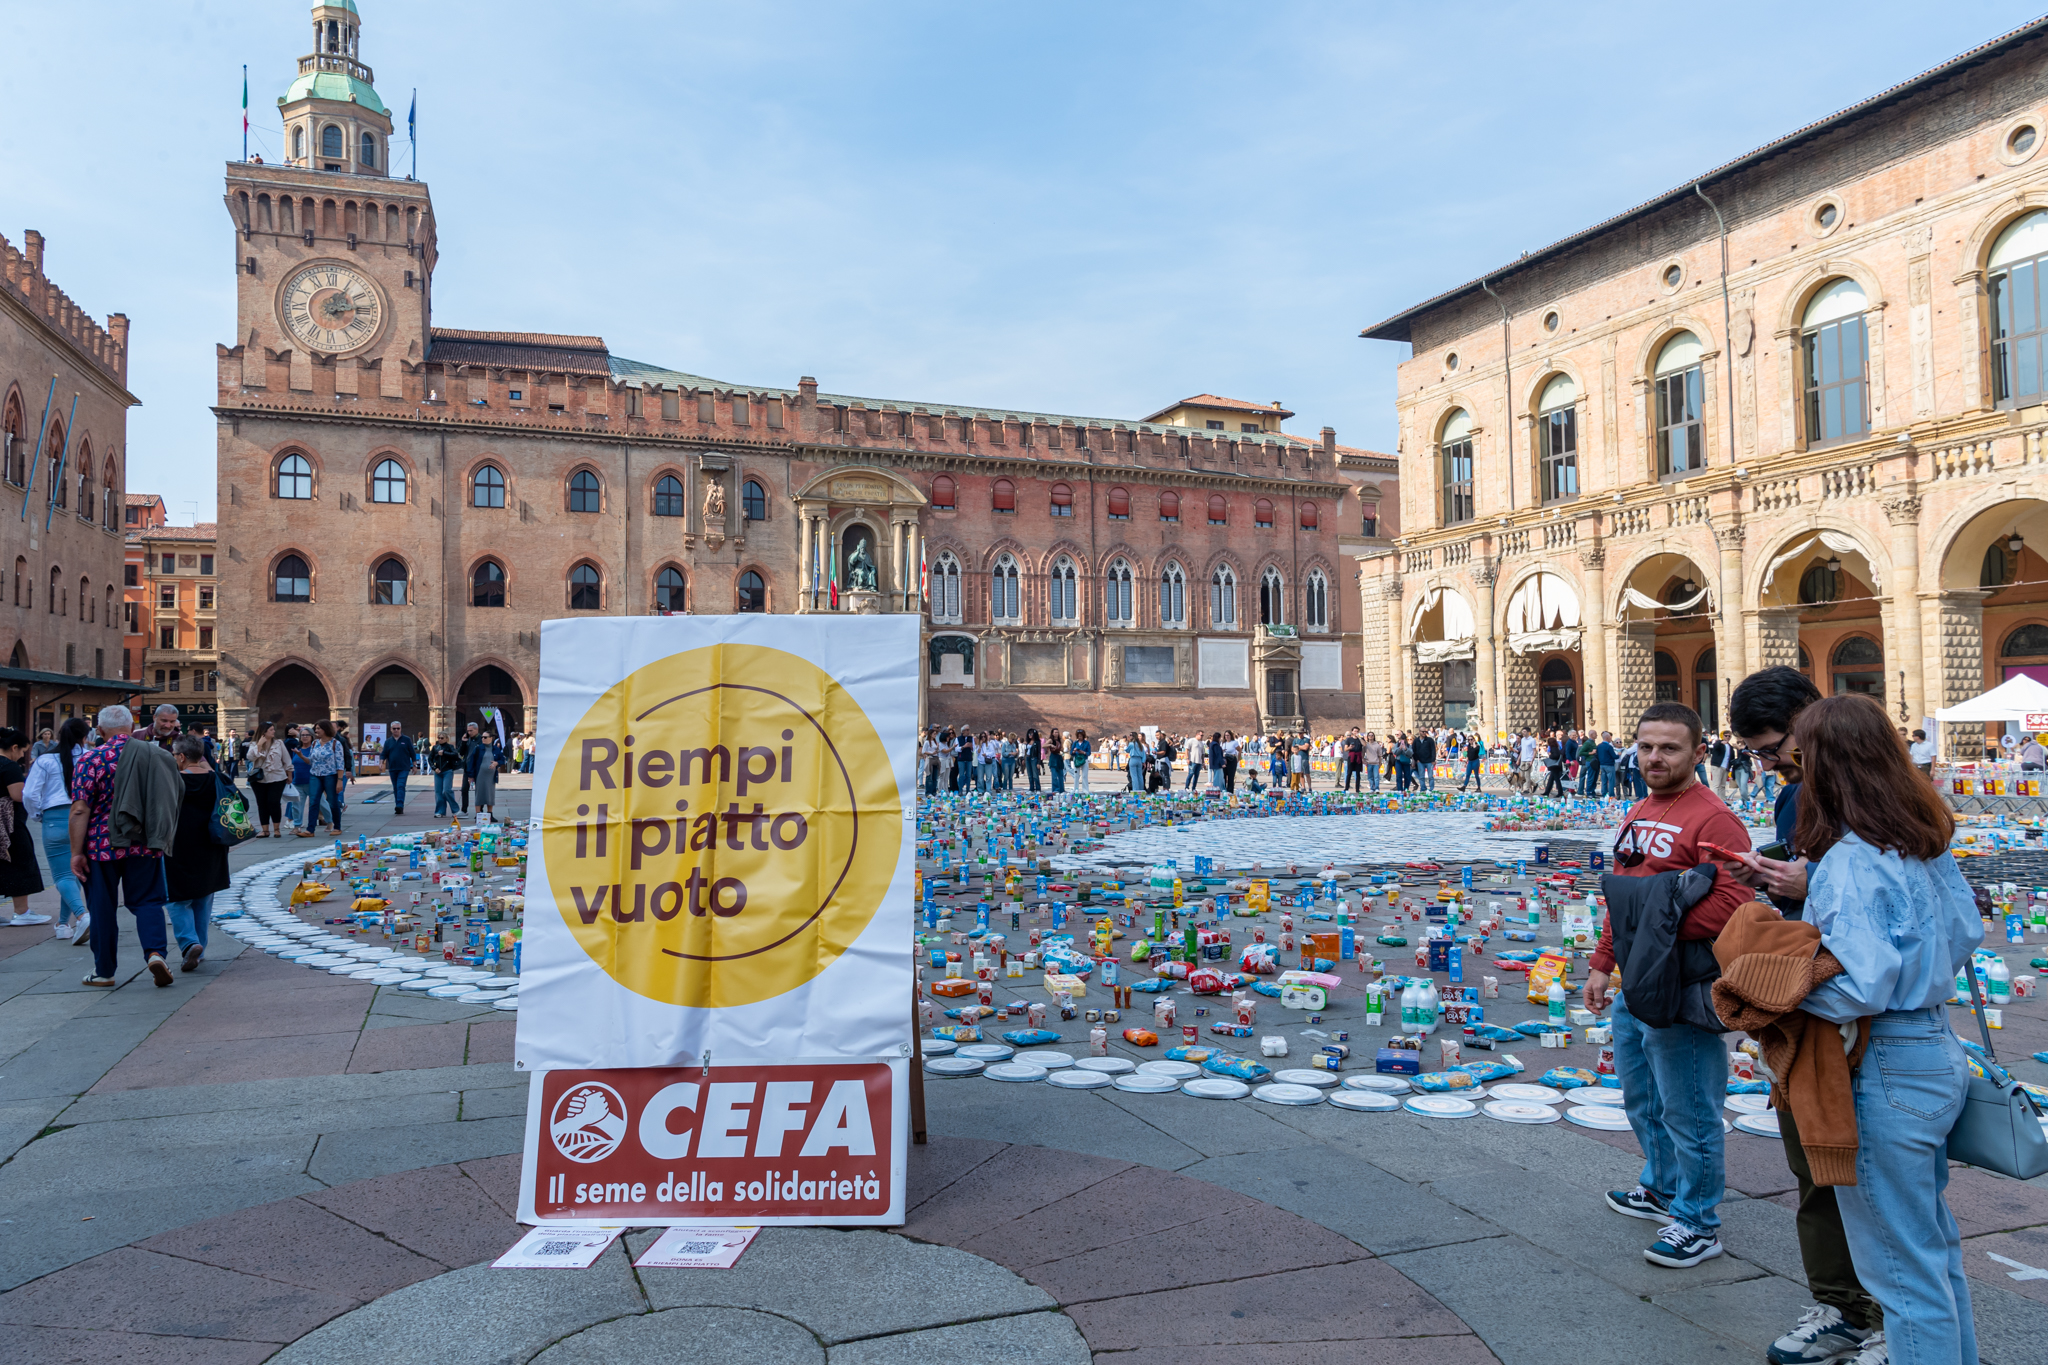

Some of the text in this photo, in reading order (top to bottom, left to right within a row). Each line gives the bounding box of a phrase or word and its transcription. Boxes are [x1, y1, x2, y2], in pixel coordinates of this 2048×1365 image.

[580, 729, 794, 796] Riempi
[576, 799, 808, 870] il piatto
[570, 866, 748, 925] vuoto
[638, 1079, 876, 1160] CEFA
[548, 1170, 880, 1204] Il seme della solidarietà
